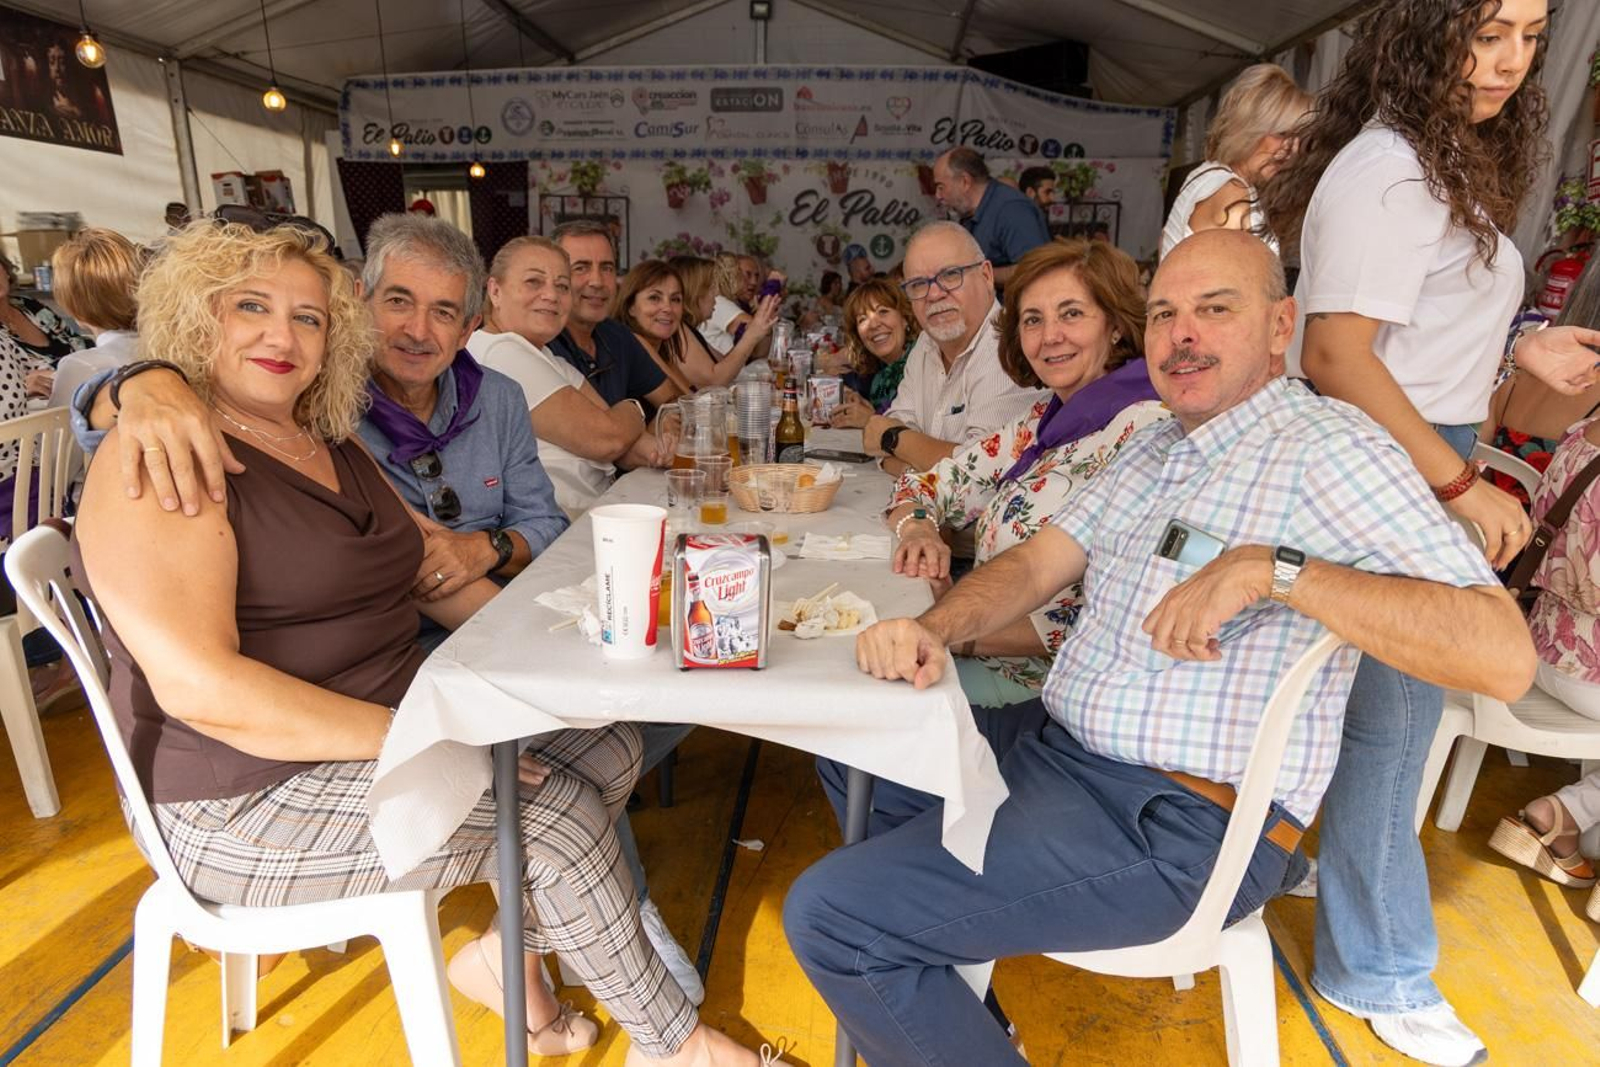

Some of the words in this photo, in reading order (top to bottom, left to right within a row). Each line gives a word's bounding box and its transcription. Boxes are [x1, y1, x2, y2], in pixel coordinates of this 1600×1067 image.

[60, 118, 116, 147] AMOR
[363, 122, 385, 144] El
[390, 123, 436, 146] Palio
[931, 117, 957, 145] El
[960, 119, 1015, 152] Palio
[789, 189, 829, 226] El
[839, 188, 920, 228] Palio
[704, 567, 755, 588] Cruzcampo
[717, 580, 747, 601] Light
